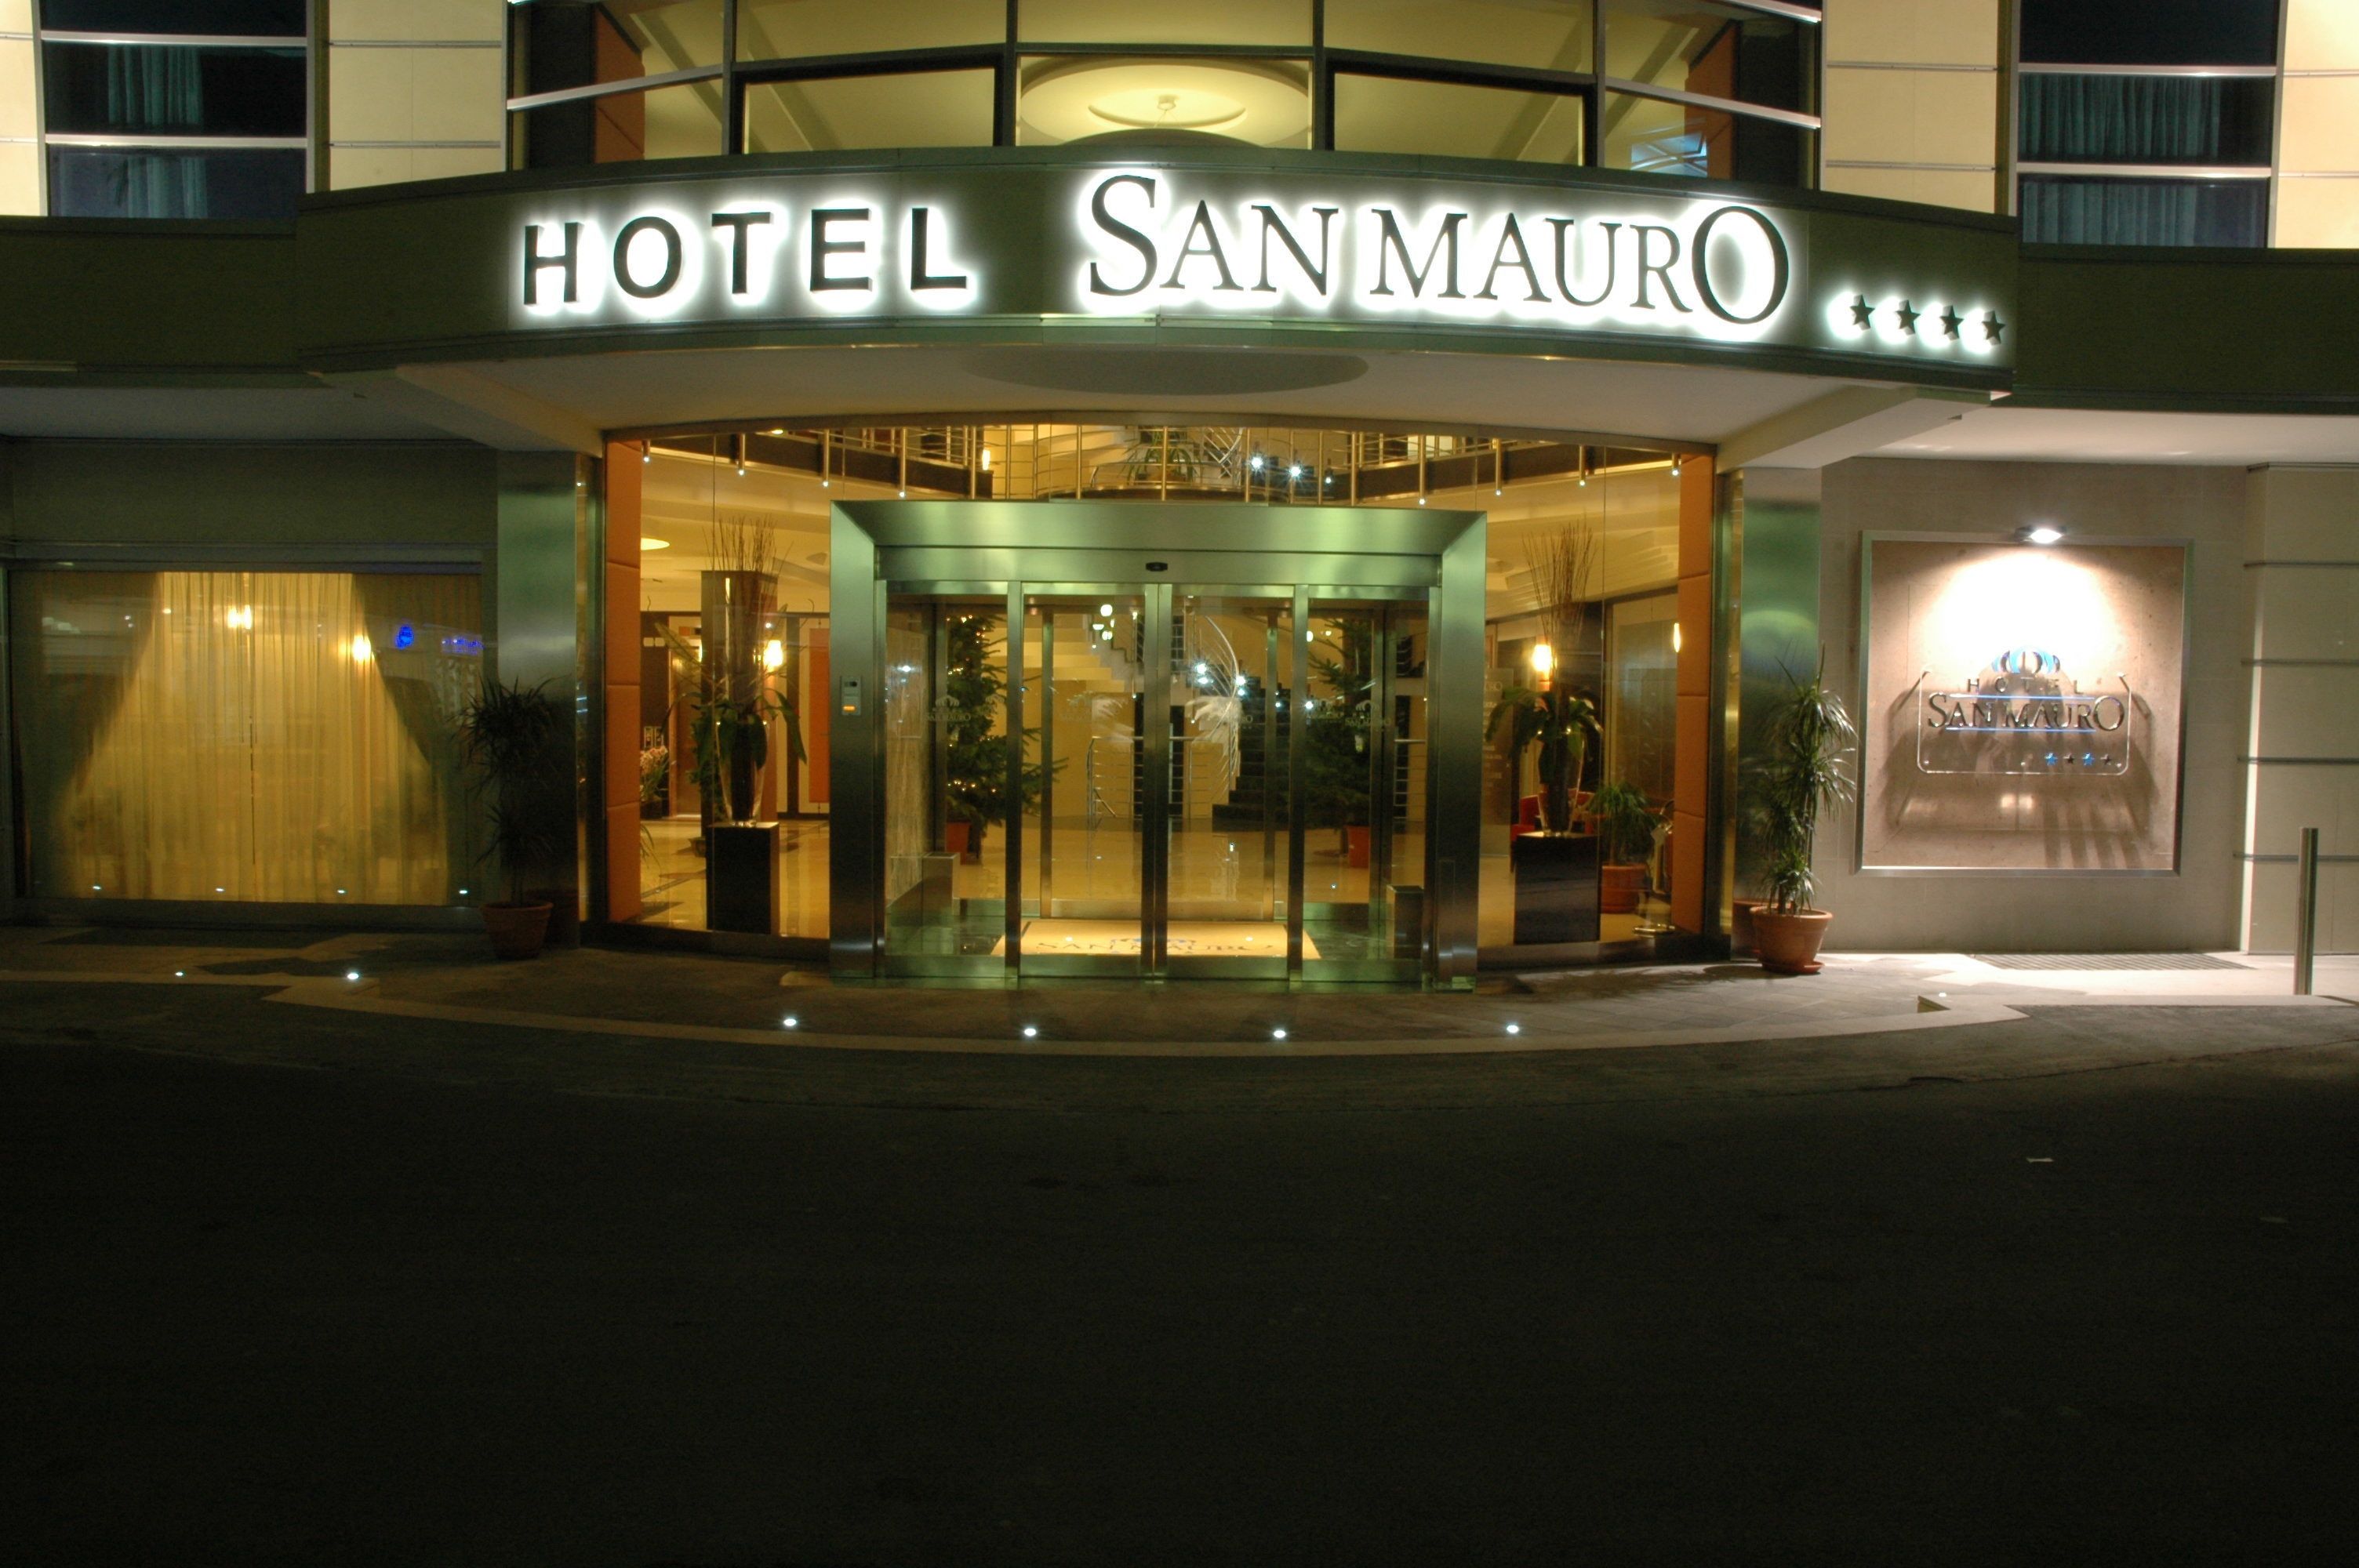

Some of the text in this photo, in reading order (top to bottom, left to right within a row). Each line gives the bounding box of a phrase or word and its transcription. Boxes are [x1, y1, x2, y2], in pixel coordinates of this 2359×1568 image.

[523, 174, 1790, 325] HOTEL SAN MAURO
[1968, 677, 2084, 695] HOTEL
[1928, 692, 2125, 731] SAN MAURO
